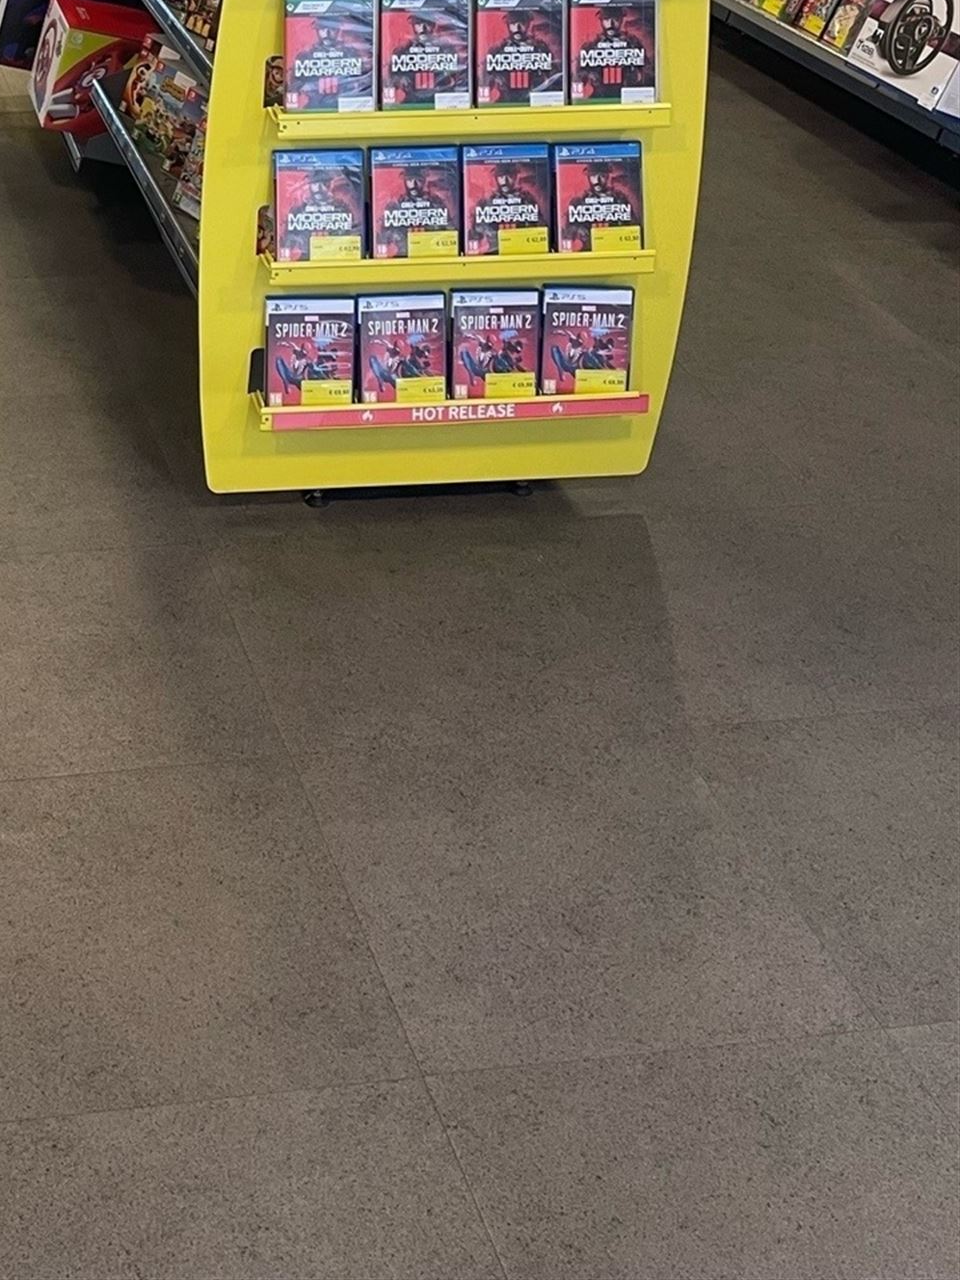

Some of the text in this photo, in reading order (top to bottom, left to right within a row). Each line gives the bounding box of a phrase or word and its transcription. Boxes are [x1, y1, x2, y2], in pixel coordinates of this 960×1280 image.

[392, 54, 458, 64] MODERN
[487, 53, 552, 63] MODERN
[580, 49, 645, 59] MODERN
[295, 58, 362, 68] MODERN
[392, 62, 457, 72] WARFARE
[487, 62, 552, 71] WARFARE
[580, 57, 644, 67] WARFARE
[295, 67, 362, 77] WARFARE
[384, 208, 448, 218] MODERN
[475, 204, 539, 214] MODERN
[568, 204, 631, 214] MODERN
[288, 213, 352, 222] MODERN
[384, 217, 448, 227] WARFARE
[476, 213, 539, 223] WARFARE
[569, 213, 631, 222] WARFARE
[288, 221, 352, 230] WARFARE
[461, 315, 532, 329] SPIDER-MAN 2
[552, 312, 625, 327] SPIDER-MAN 2
[275, 323, 347, 337] SPIDER-MAN 2
[368, 319, 438, 335] SPIDER-MAN 2
[412, 404, 516, 421] HOT RELEASE
